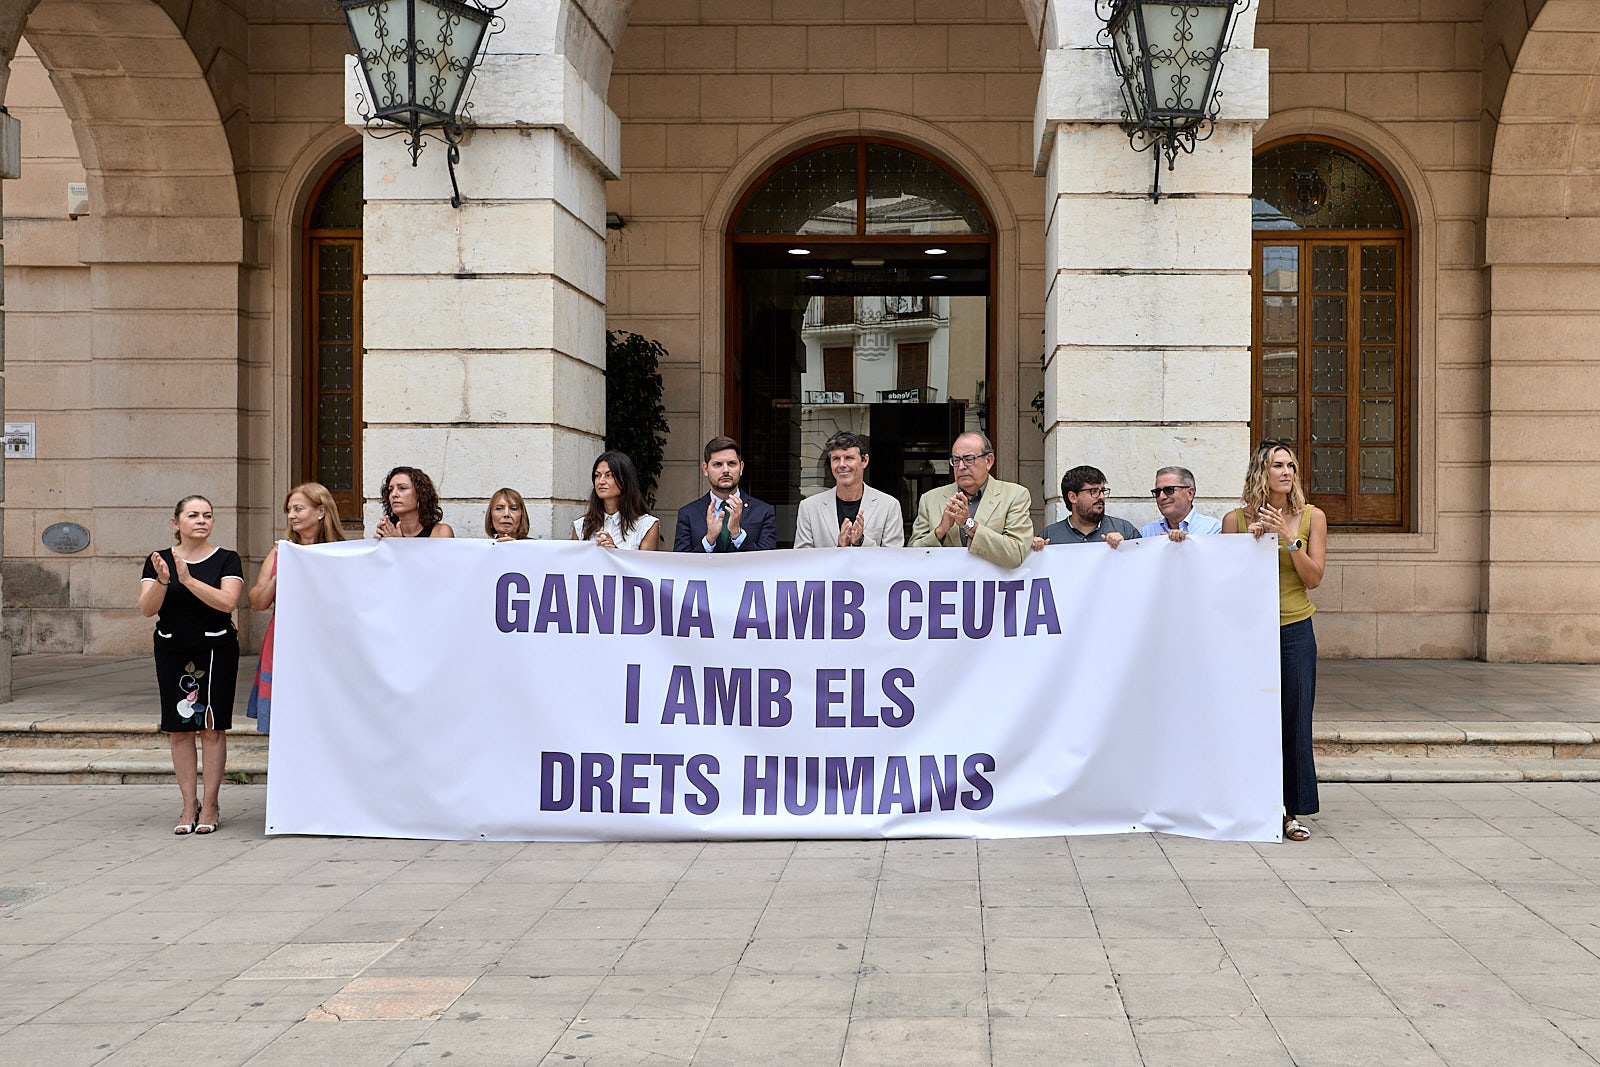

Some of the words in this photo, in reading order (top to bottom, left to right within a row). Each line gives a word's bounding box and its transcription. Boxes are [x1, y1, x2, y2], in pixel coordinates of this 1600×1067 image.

[495, 571, 715, 639] GANDIA
[732, 580, 866, 640] AMB
[887, 577, 1062, 641] CEUTA
[624, 663, 641, 724] I
[660, 664, 793, 728] AMB
[815, 667, 915, 729] ELS
[539, 750, 721, 816] DRETS
[742, 752, 996, 816] HUMANS
